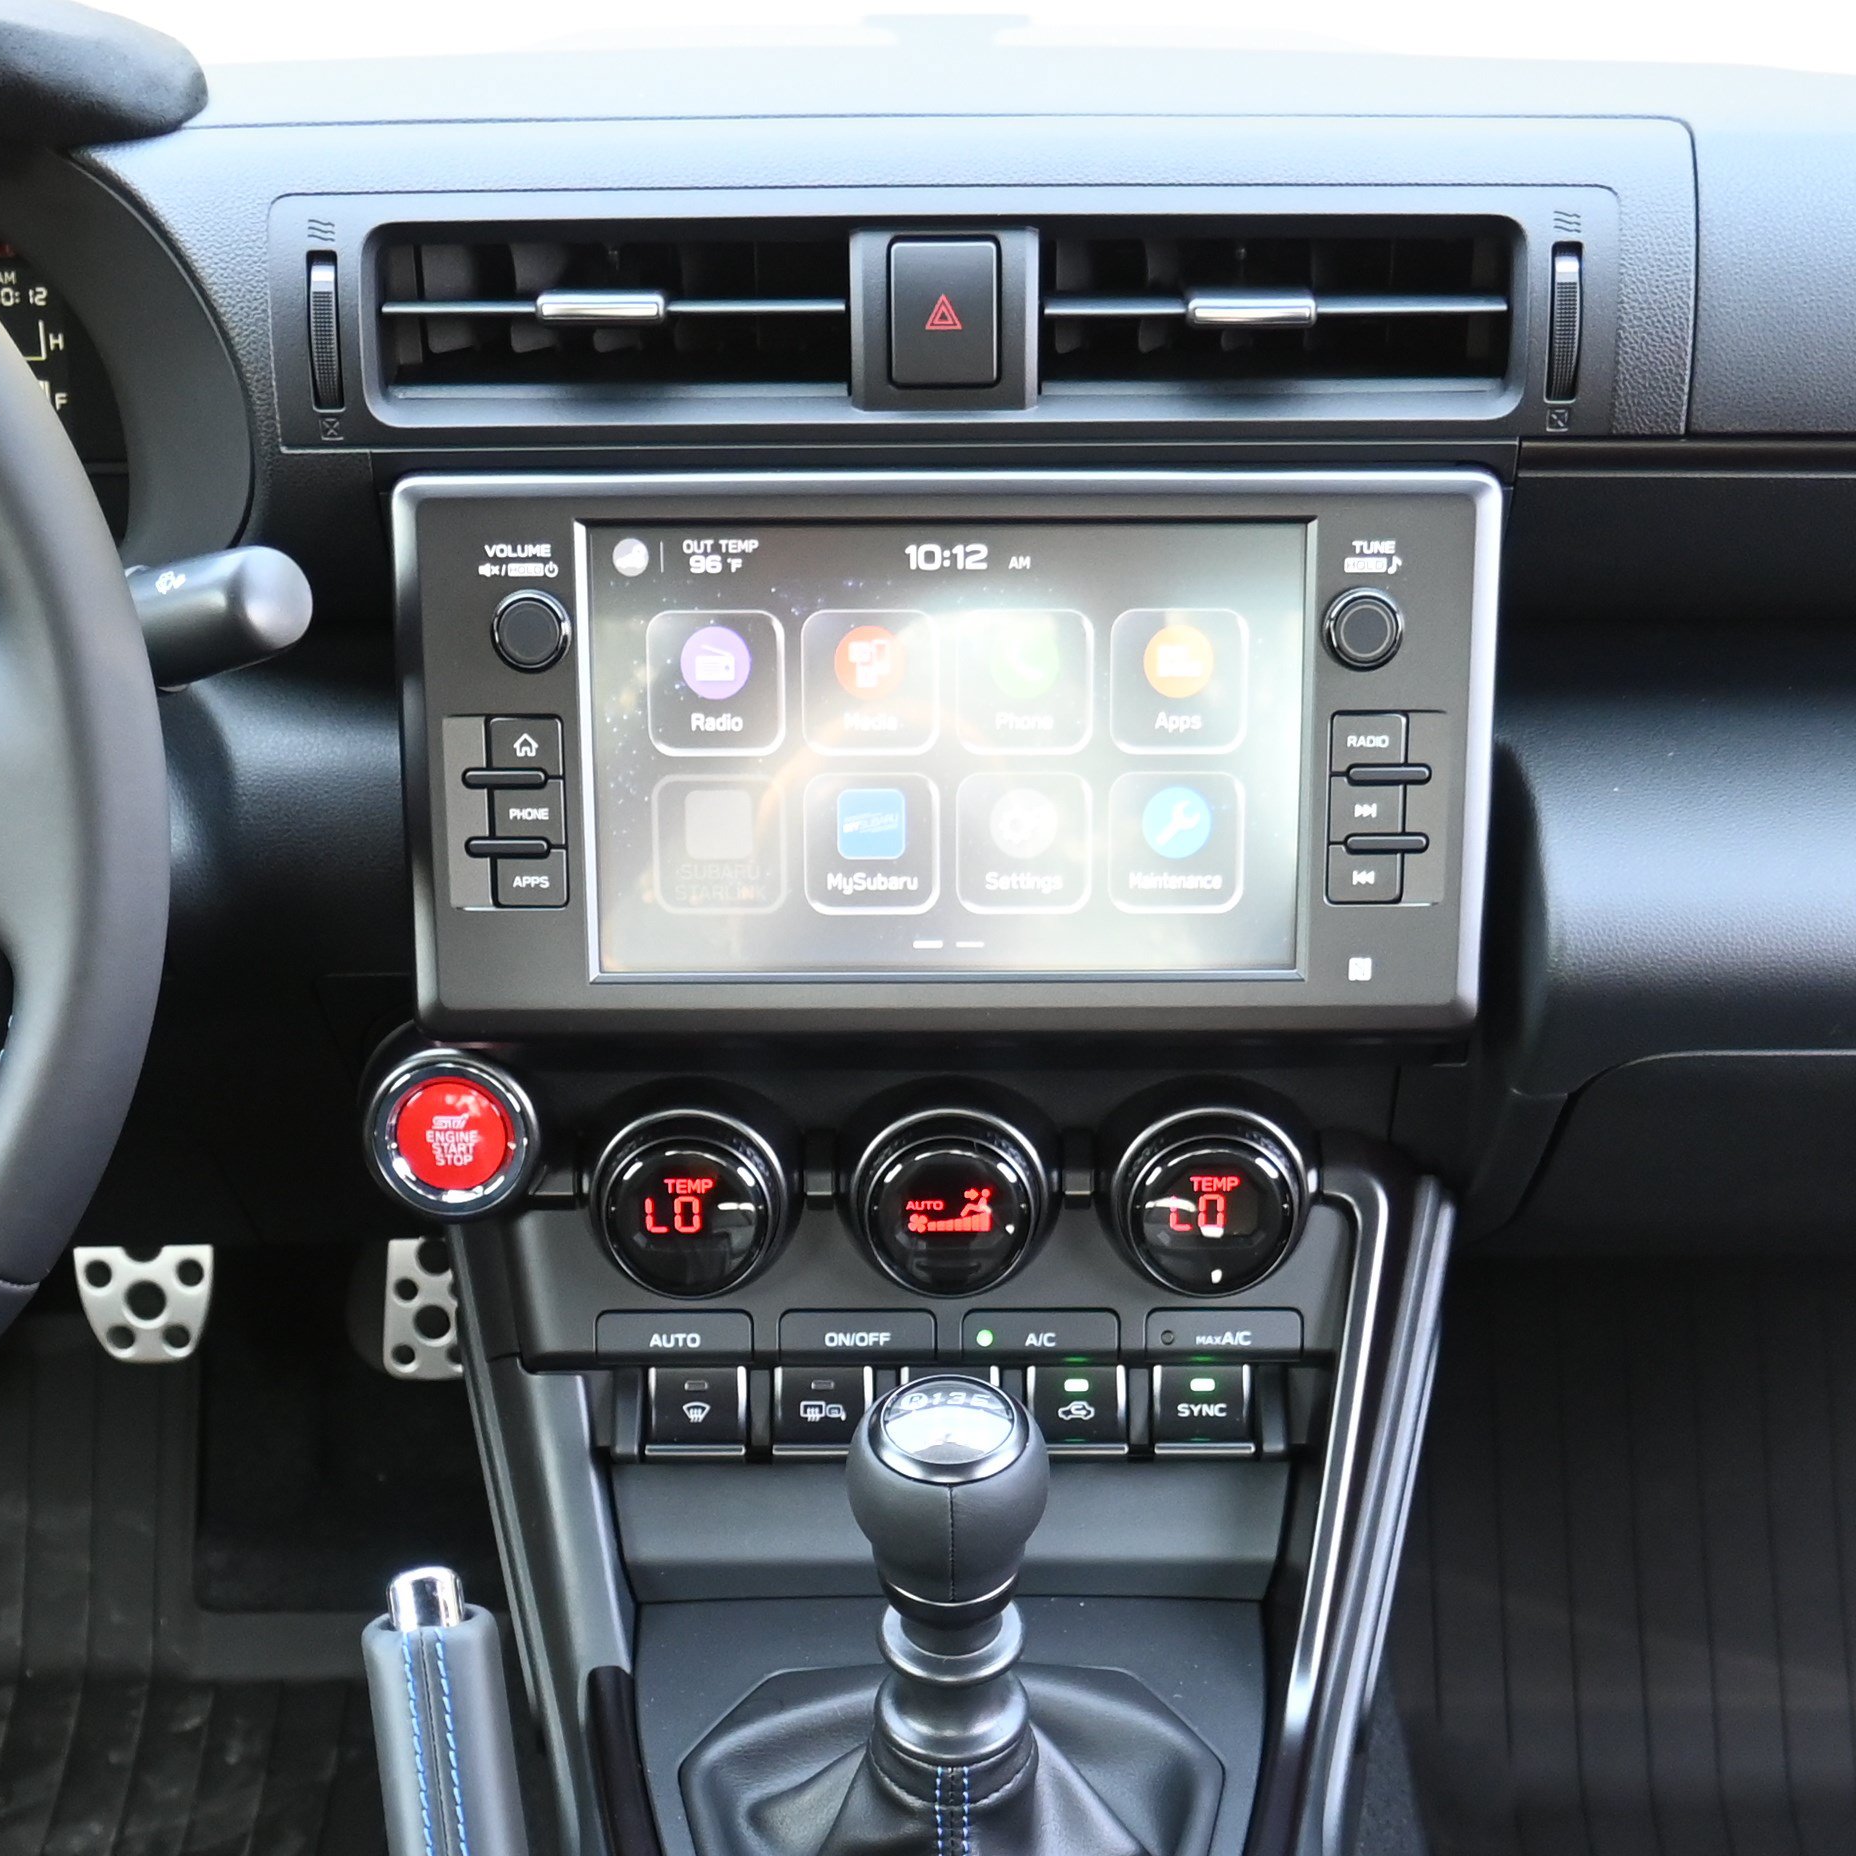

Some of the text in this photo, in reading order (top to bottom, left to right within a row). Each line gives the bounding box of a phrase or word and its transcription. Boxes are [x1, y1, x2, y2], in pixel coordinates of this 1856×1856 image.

[48, 332, 65, 352] H
[483, 543, 553, 558] VOLUME
[682, 539, 760, 555] OUT TEMP
[1351, 540, 1397, 555] TUNE
[688, 556, 723, 575] 96
[904, 543, 1032, 572] 10:12 AM
[690, 713, 745, 733] Radio
[995, 712, 1055, 732] Phone
[1154, 712, 1203, 733] Apps
[1346, 734, 1390, 749] RADIO
[508, 806, 550, 821] PHONE
[512, 875, 550, 890] APPS
[826, 872, 919, 895] MySubaru
[984, 871, 1064, 894] Settings
[1128, 871, 1223, 890] Maintenance
[425, 1130, 480, 1143] ENGINE
[431, 1142, 476, 1155] START
[435, 1154, 474, 1167] STOP
[663, 1178, 714, 1195] TEMP
[1189, 1176, 1240, 1193] TEMP
[905, 1199, 944, 1212] AUTO
[644, 1196, 703, 1235] LO
[1168, 1193, 1227, 1236] LO
[648, 1332, 702, 1349] AUTO
[824, 1331, 892, 1348] ON/OFF
[1024, 1331, 1058, 1349] A/C
[1176, 1403, 1228, 1419] SYNC
